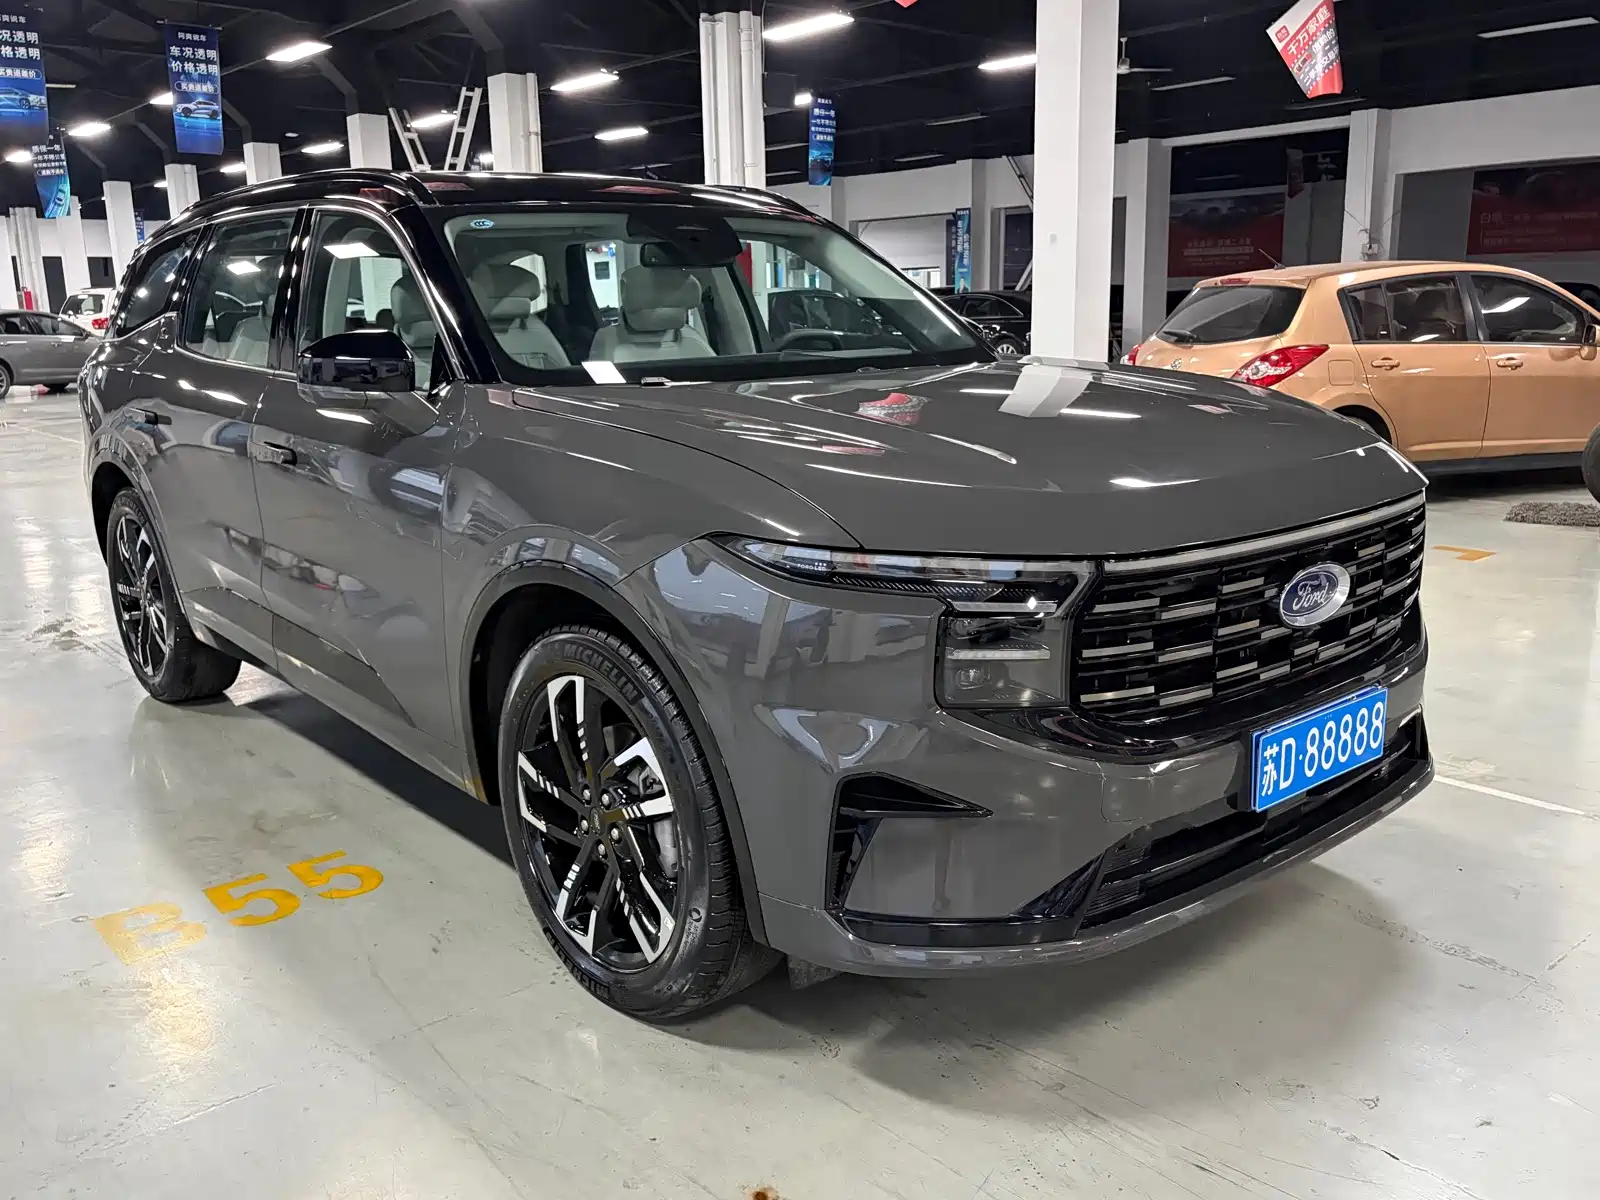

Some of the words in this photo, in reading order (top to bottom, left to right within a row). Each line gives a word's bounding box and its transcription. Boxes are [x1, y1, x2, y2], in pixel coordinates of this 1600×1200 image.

[1287, 5, 1331, 55] 千万家庭
[170, 46, 217, 61] 车况透明
[171, 61, 218, 76] 价格透明
[1293, 574, 1329, 611] Ford
[563, 643, 639, 701] MICHELIN
